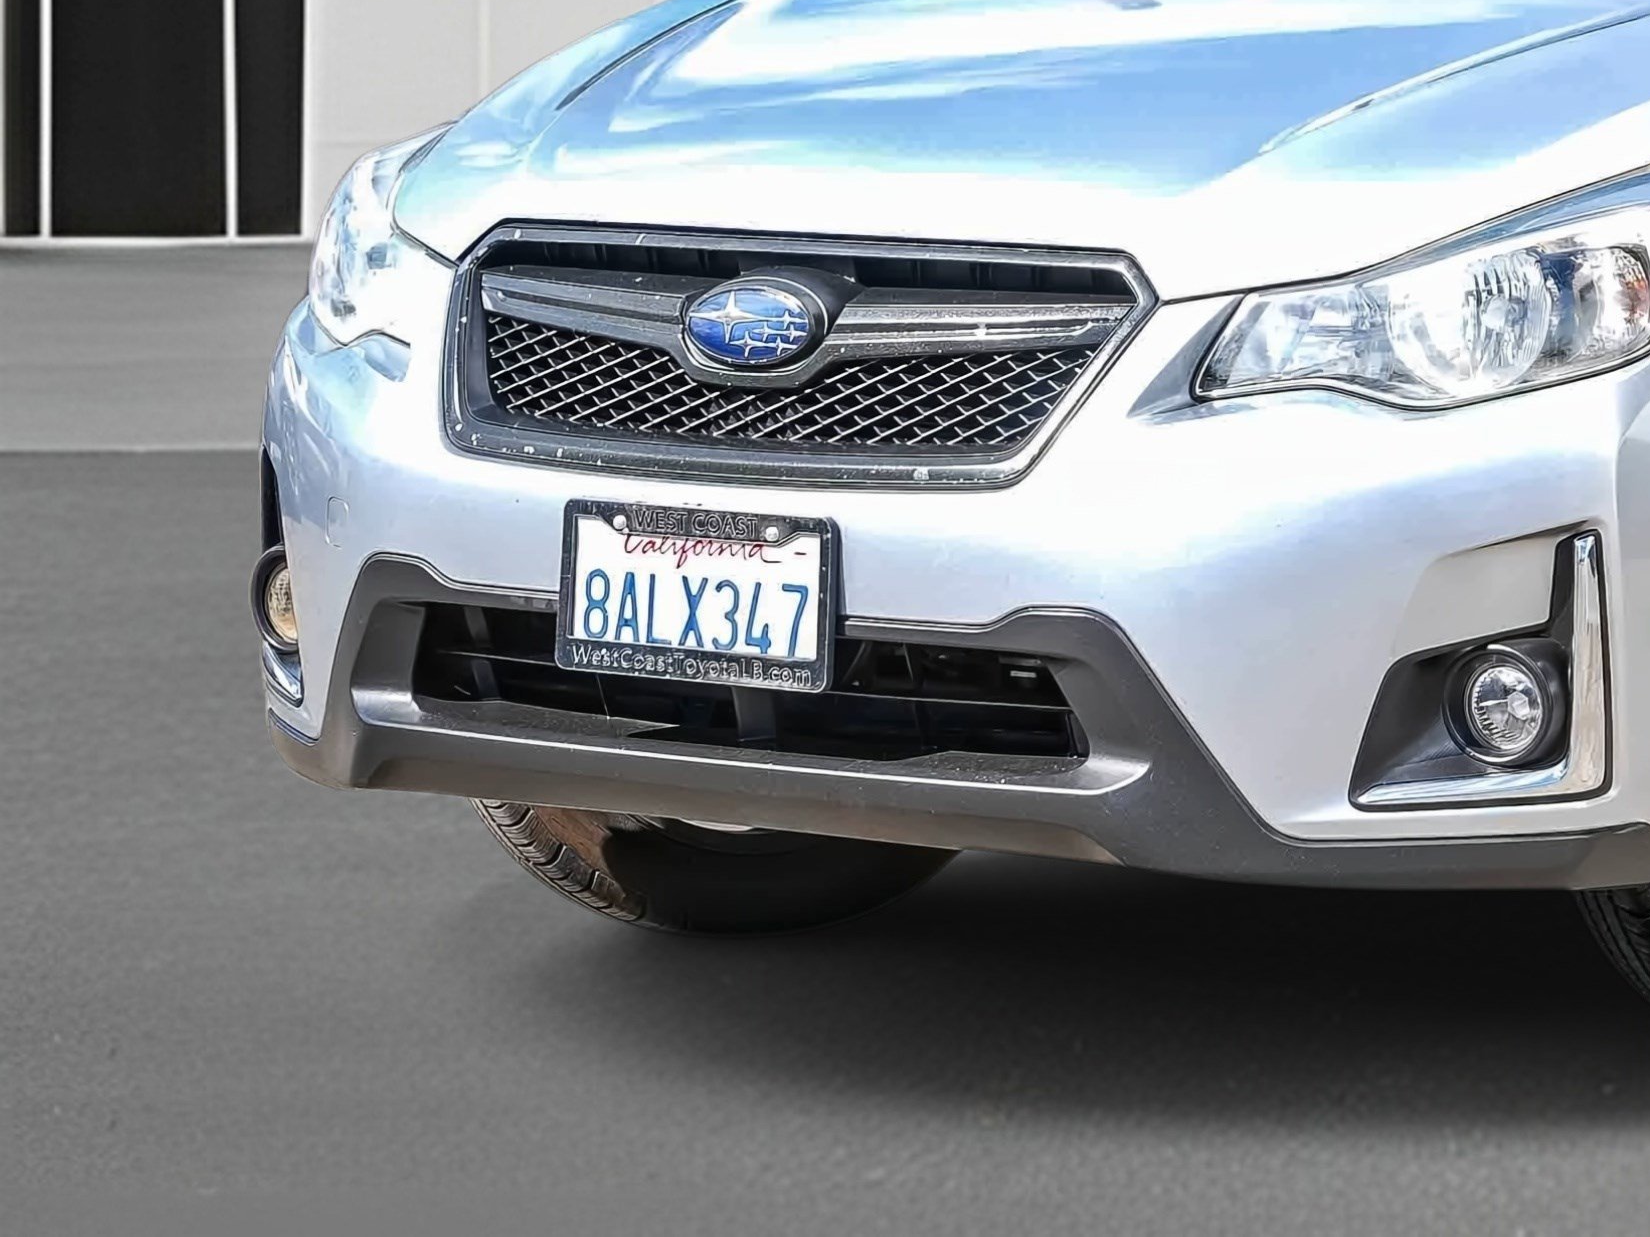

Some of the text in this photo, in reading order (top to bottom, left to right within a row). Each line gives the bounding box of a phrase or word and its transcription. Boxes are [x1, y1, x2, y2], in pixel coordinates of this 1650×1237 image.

[633, 509, 759, 538] WEST COAST
[583, 568, 809, 660] 8ALX347
[571, 641, 812, 687] WestCoastToyotaLB.com
